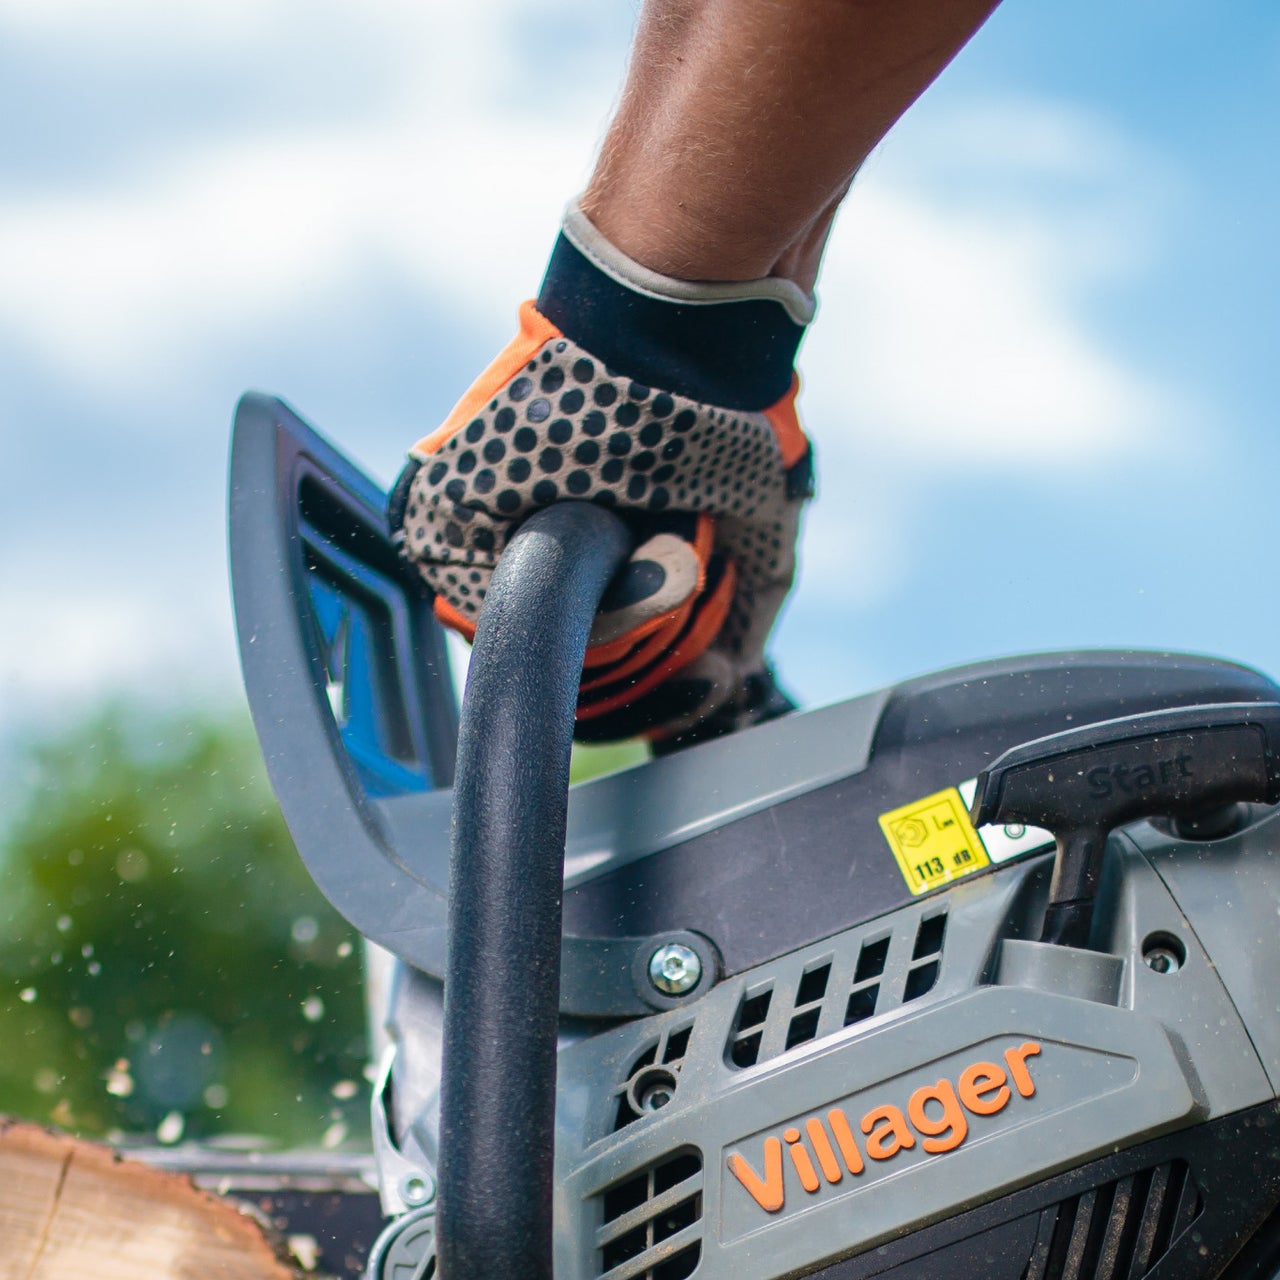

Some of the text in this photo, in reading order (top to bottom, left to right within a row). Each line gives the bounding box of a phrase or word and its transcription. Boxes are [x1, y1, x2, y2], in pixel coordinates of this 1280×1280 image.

[1086, 751, 1193, 799] Start
[915, 857, 944, 880] 113
[727, 1042, 1041, 1213] Villager
